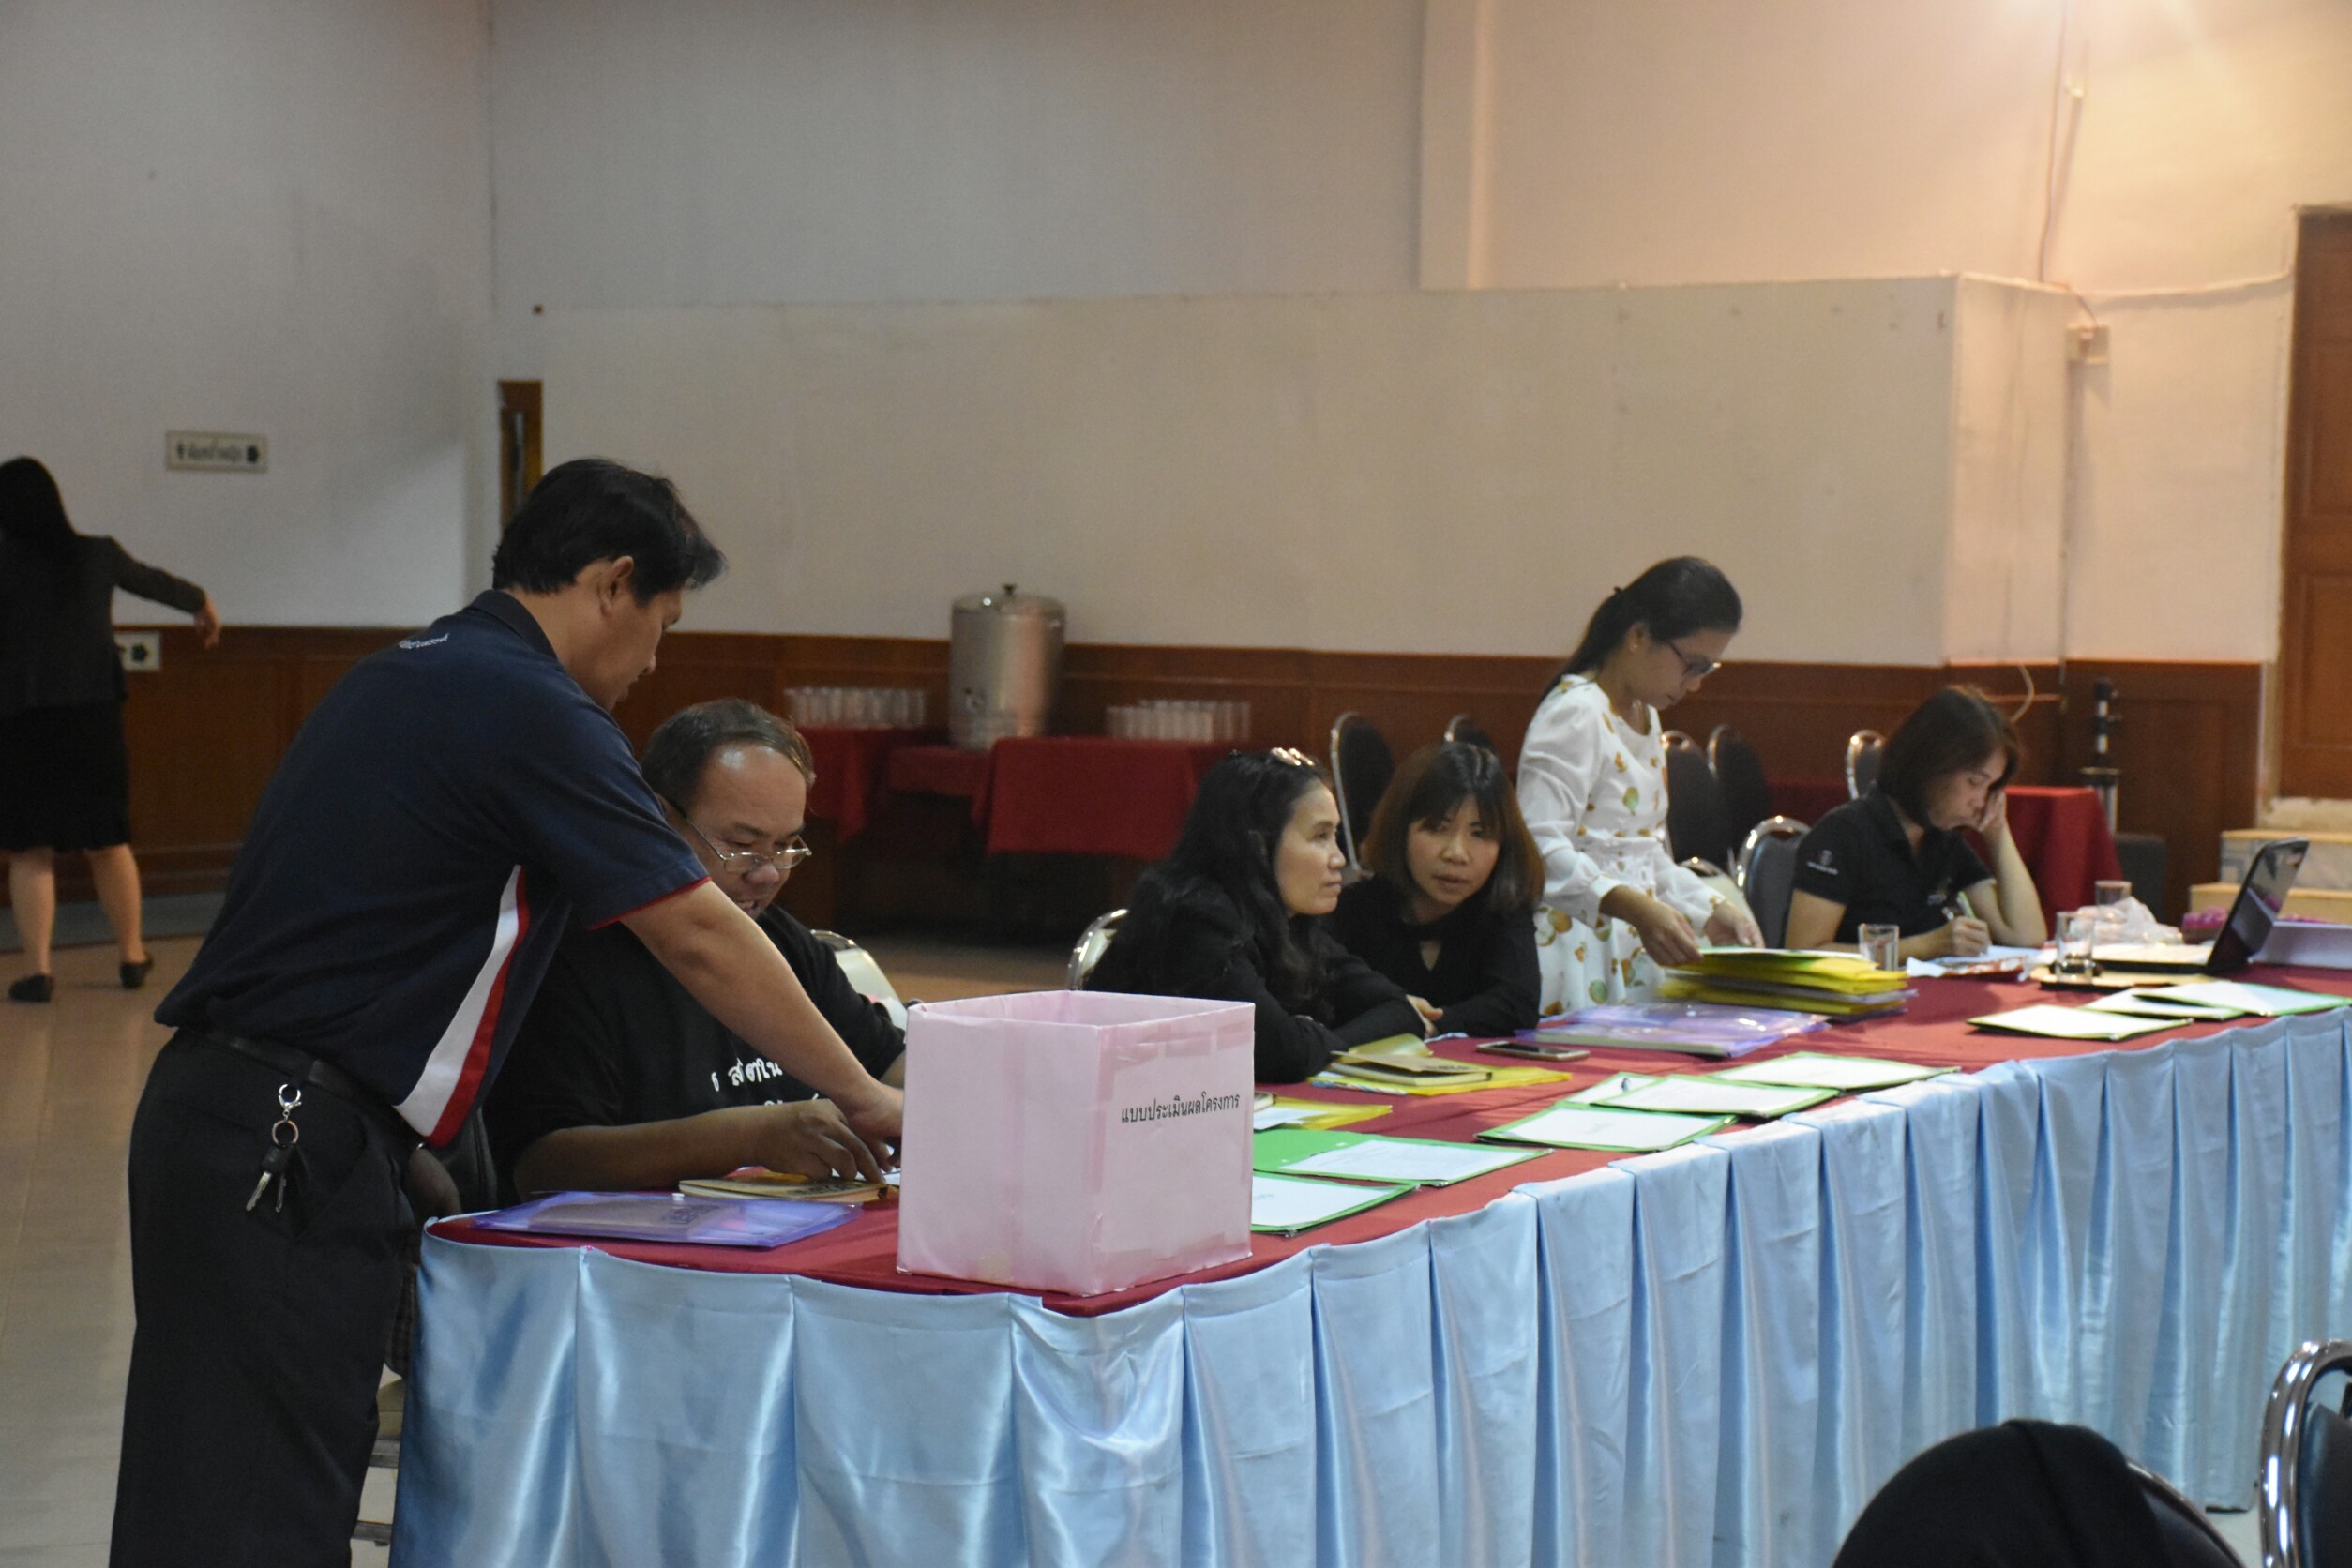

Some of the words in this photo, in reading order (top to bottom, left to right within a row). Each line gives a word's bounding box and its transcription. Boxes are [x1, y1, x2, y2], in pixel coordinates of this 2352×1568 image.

[1121, 1091, 1240, 1123] แบบประเมินผลโครงการ
